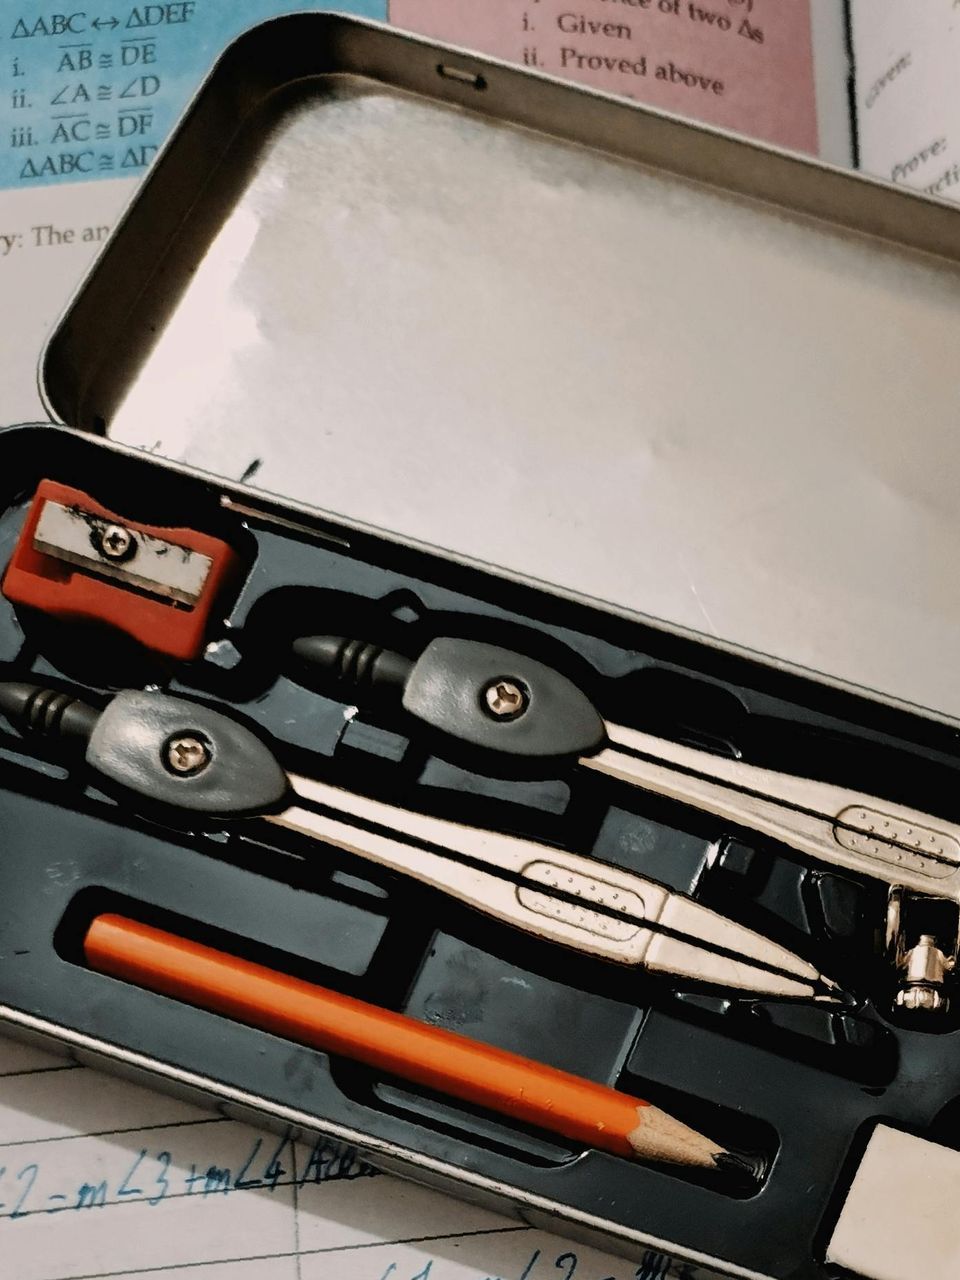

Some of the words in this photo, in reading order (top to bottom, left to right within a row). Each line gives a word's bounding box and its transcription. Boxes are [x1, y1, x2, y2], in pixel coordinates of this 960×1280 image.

[556, 12, 633, 41] Given
[689, 5, 732, 32] two
[522, 47, 545, 68] ii.
[560, 47, 648, 77] Proved
[654, 60, 726, 96] above
[12, 88, 32, 109] ii.
[11, 126, 39, 148] iii.
[31, 224, 75, 247] The
